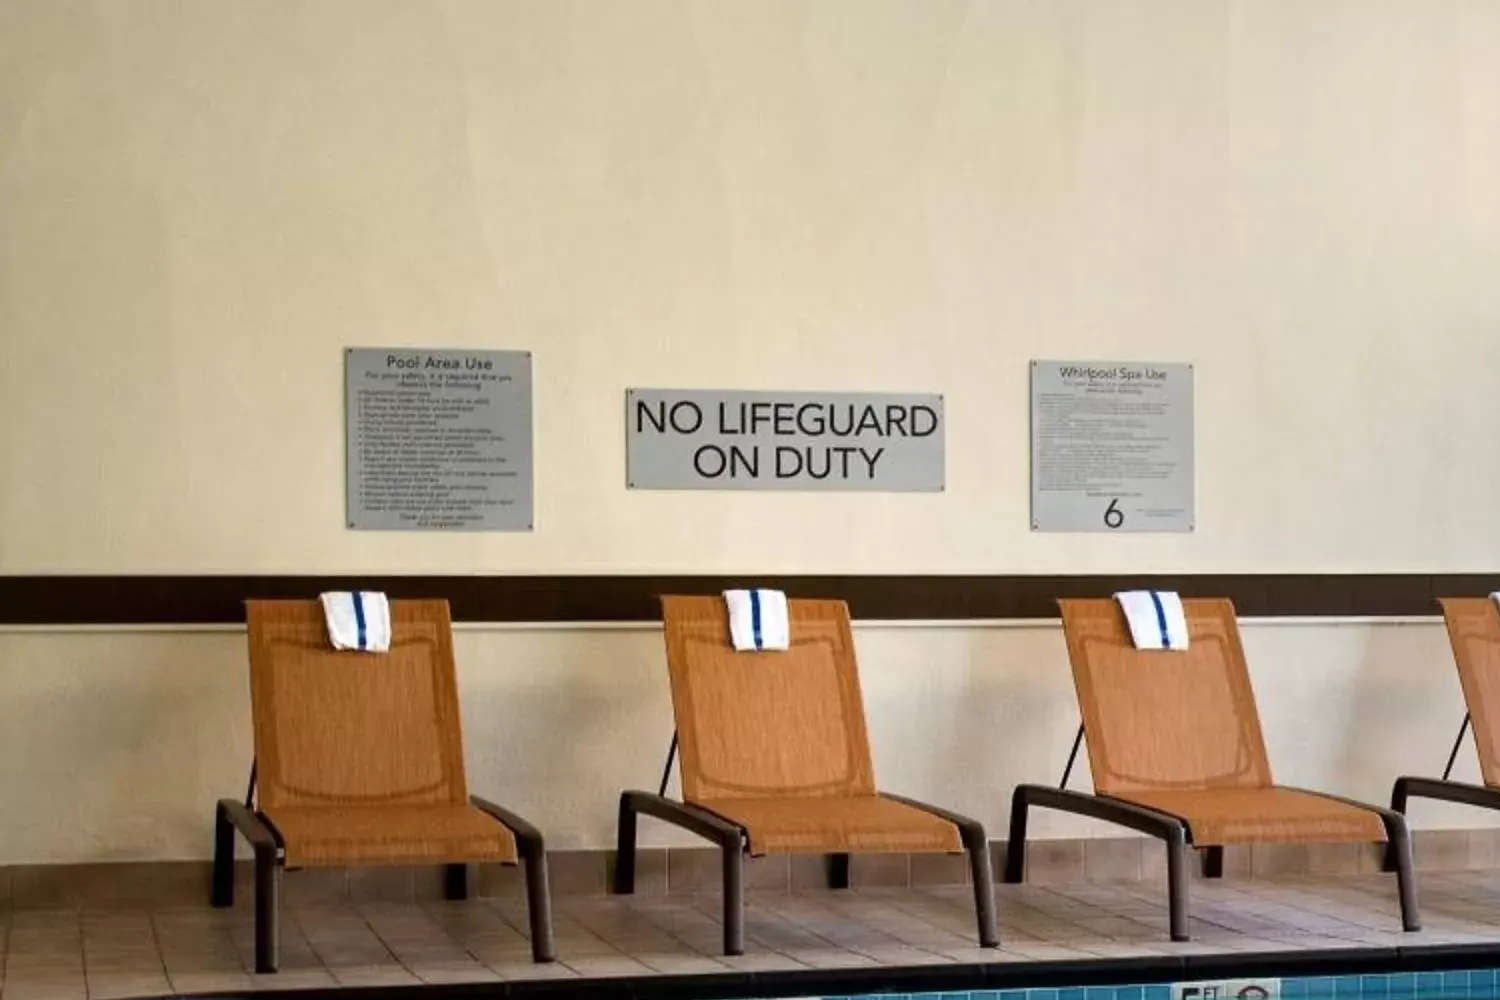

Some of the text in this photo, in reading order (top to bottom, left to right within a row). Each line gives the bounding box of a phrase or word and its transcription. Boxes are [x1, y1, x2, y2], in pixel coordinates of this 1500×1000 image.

[386, 354, 494, 371] Pool Area Use
[1058, 366, 1168, 382] Whirlpool Spa Use
[636, 400, 938, 438] NO LIFEGUARD
[693, 444, 885, 480] ON DUTY
[1103, 497, 1124, 529] 6
